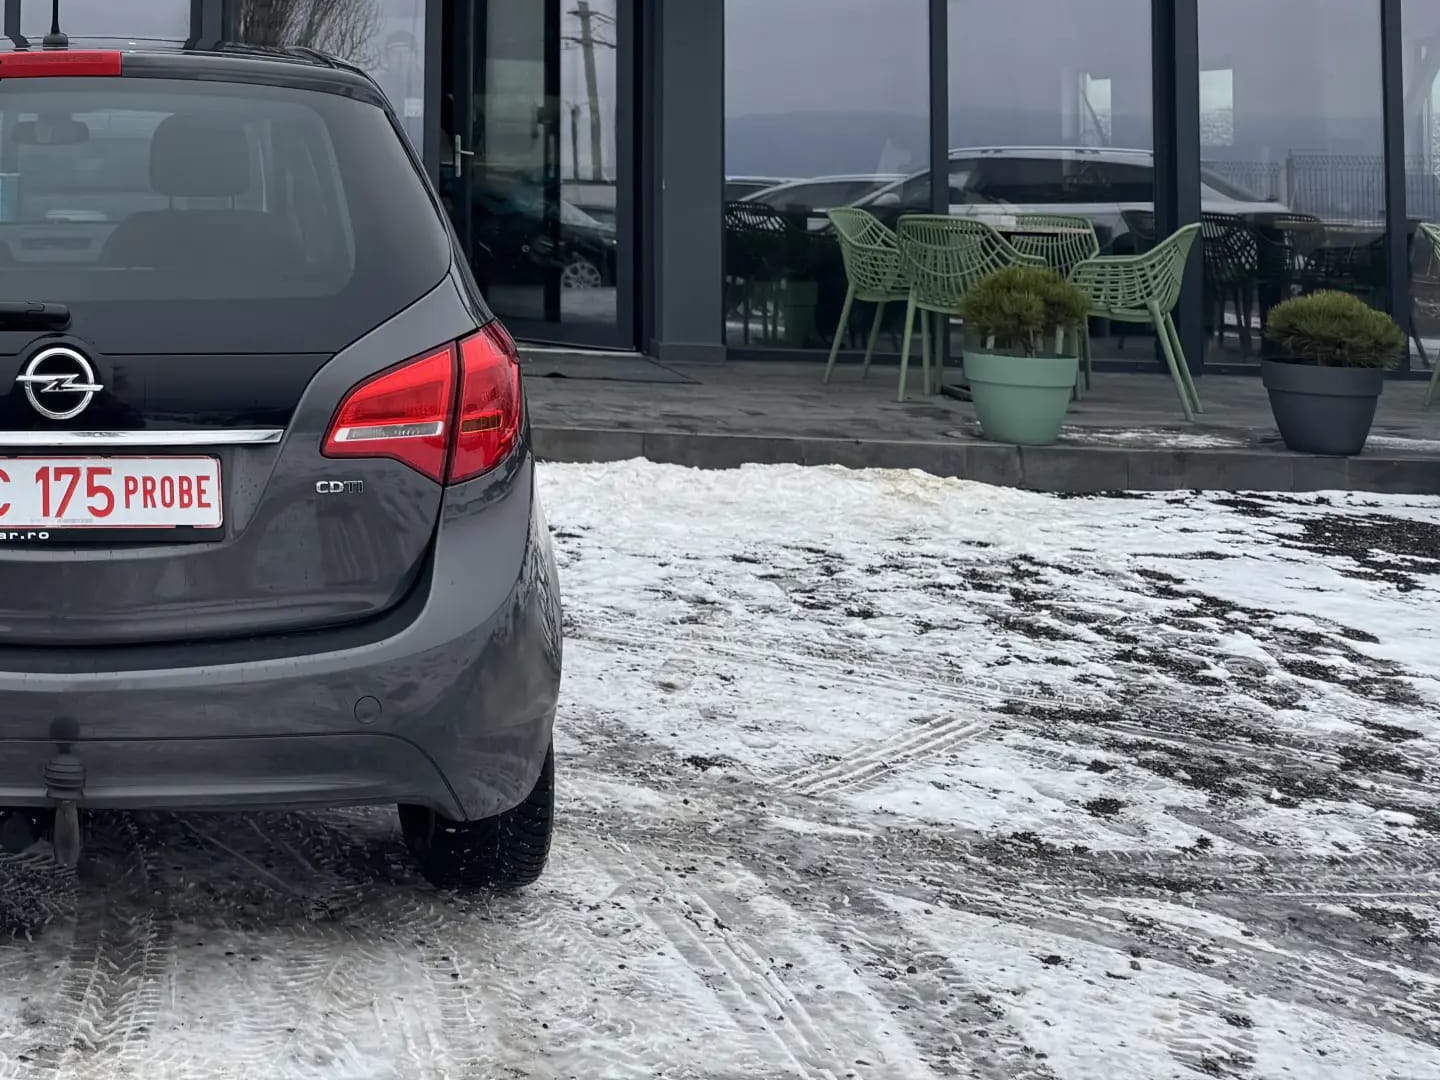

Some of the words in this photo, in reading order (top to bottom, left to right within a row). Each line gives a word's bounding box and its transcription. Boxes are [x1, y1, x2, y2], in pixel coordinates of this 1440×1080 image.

[35, 466, 115, 518] 175
[124, 475, 212, 509] PROBE
[315, 480, 363, 493] CDTI
